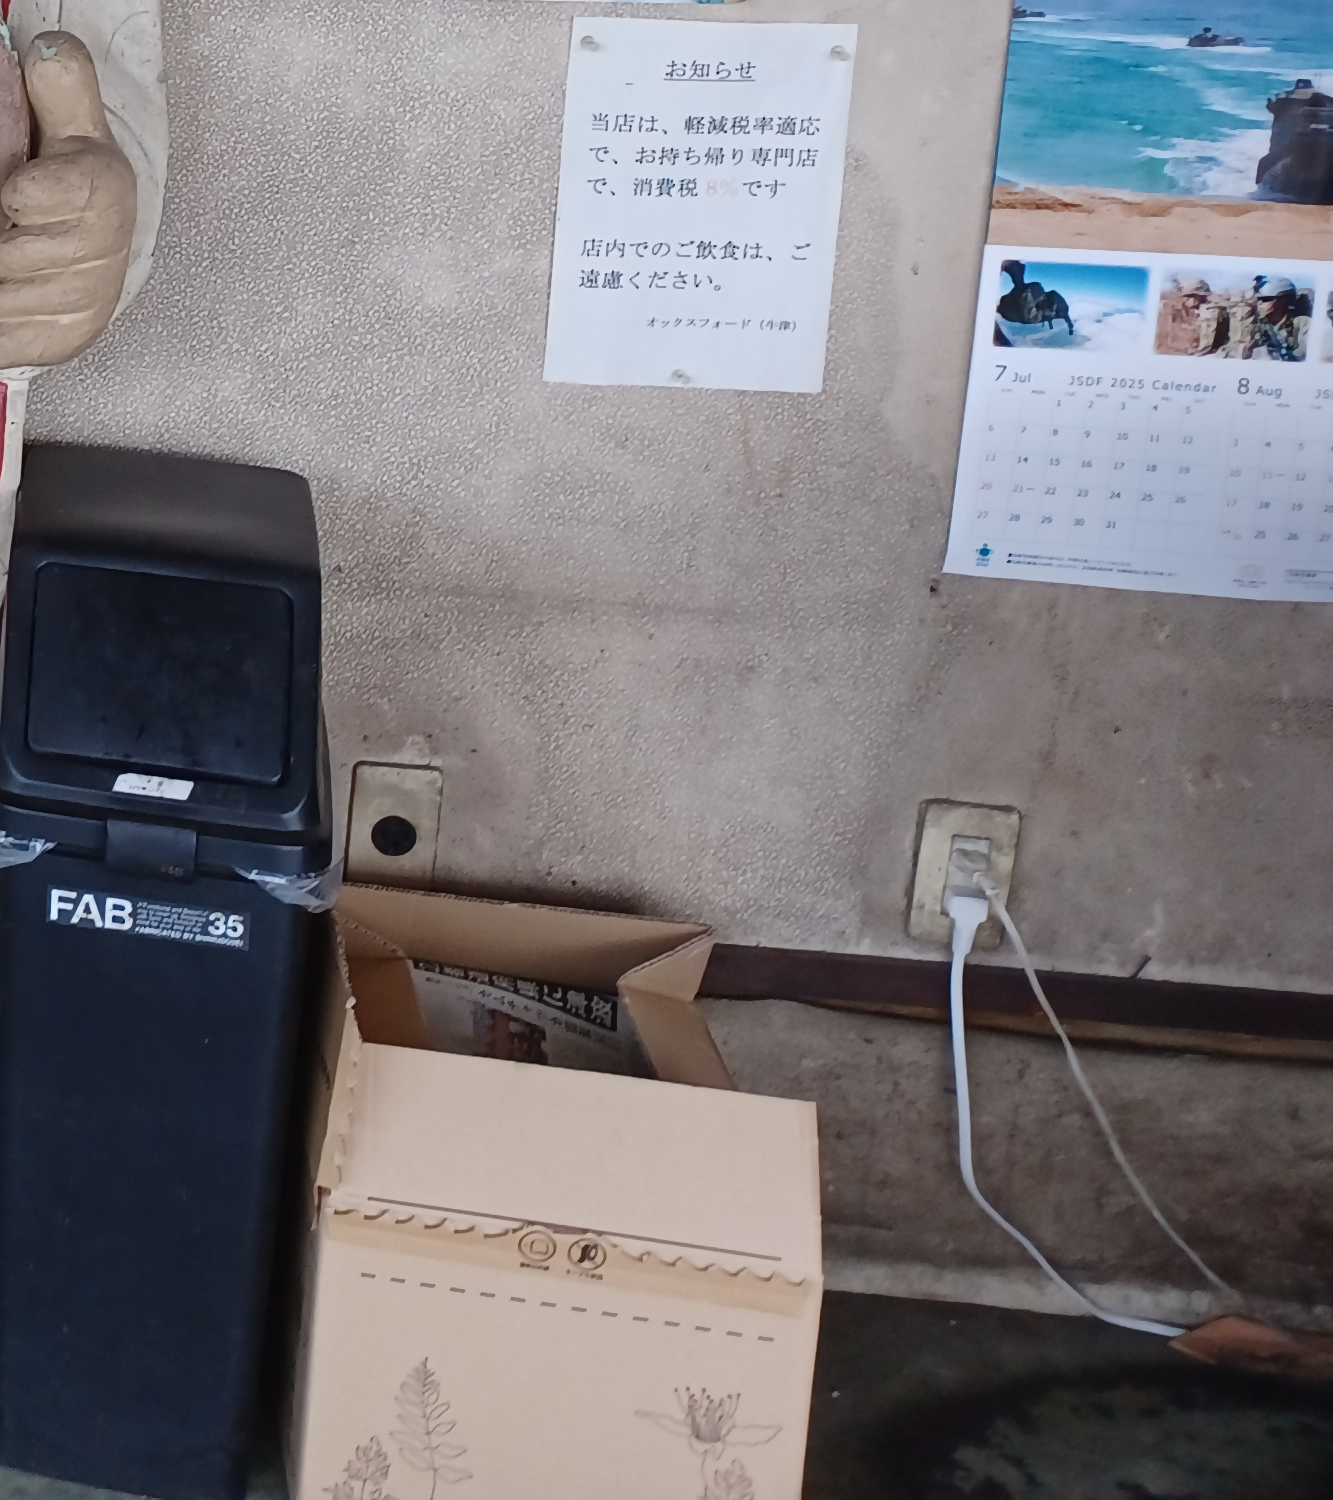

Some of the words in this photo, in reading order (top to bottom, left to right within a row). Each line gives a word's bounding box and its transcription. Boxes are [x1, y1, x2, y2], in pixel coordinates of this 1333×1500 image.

[665, 59, 756, 80] お知らせ
[591, 113, 821, 136] 当店は、軽減税率適応
[589, 146, 819, 168] で、お持ち帰り専門店
[580, 240, 812, 262] 店内でのご飲食は、ご
[578, 269, 722, 292] 遠慮ください。
[995, 365, 1007, 381] 7
[1012, 372, 1031, 383] Jul
[1069, 376, 1103, 387] JSDF
[1110, 378, 1145, 389] 2025
[1152, 379, 1217, 393] Calendar
[1237, 378, 1249, 395] 8
[1255, 385, 1283, 399] Aug
[49, 888, 134, 931] FAB
[207, 911, 244, 938] 35
